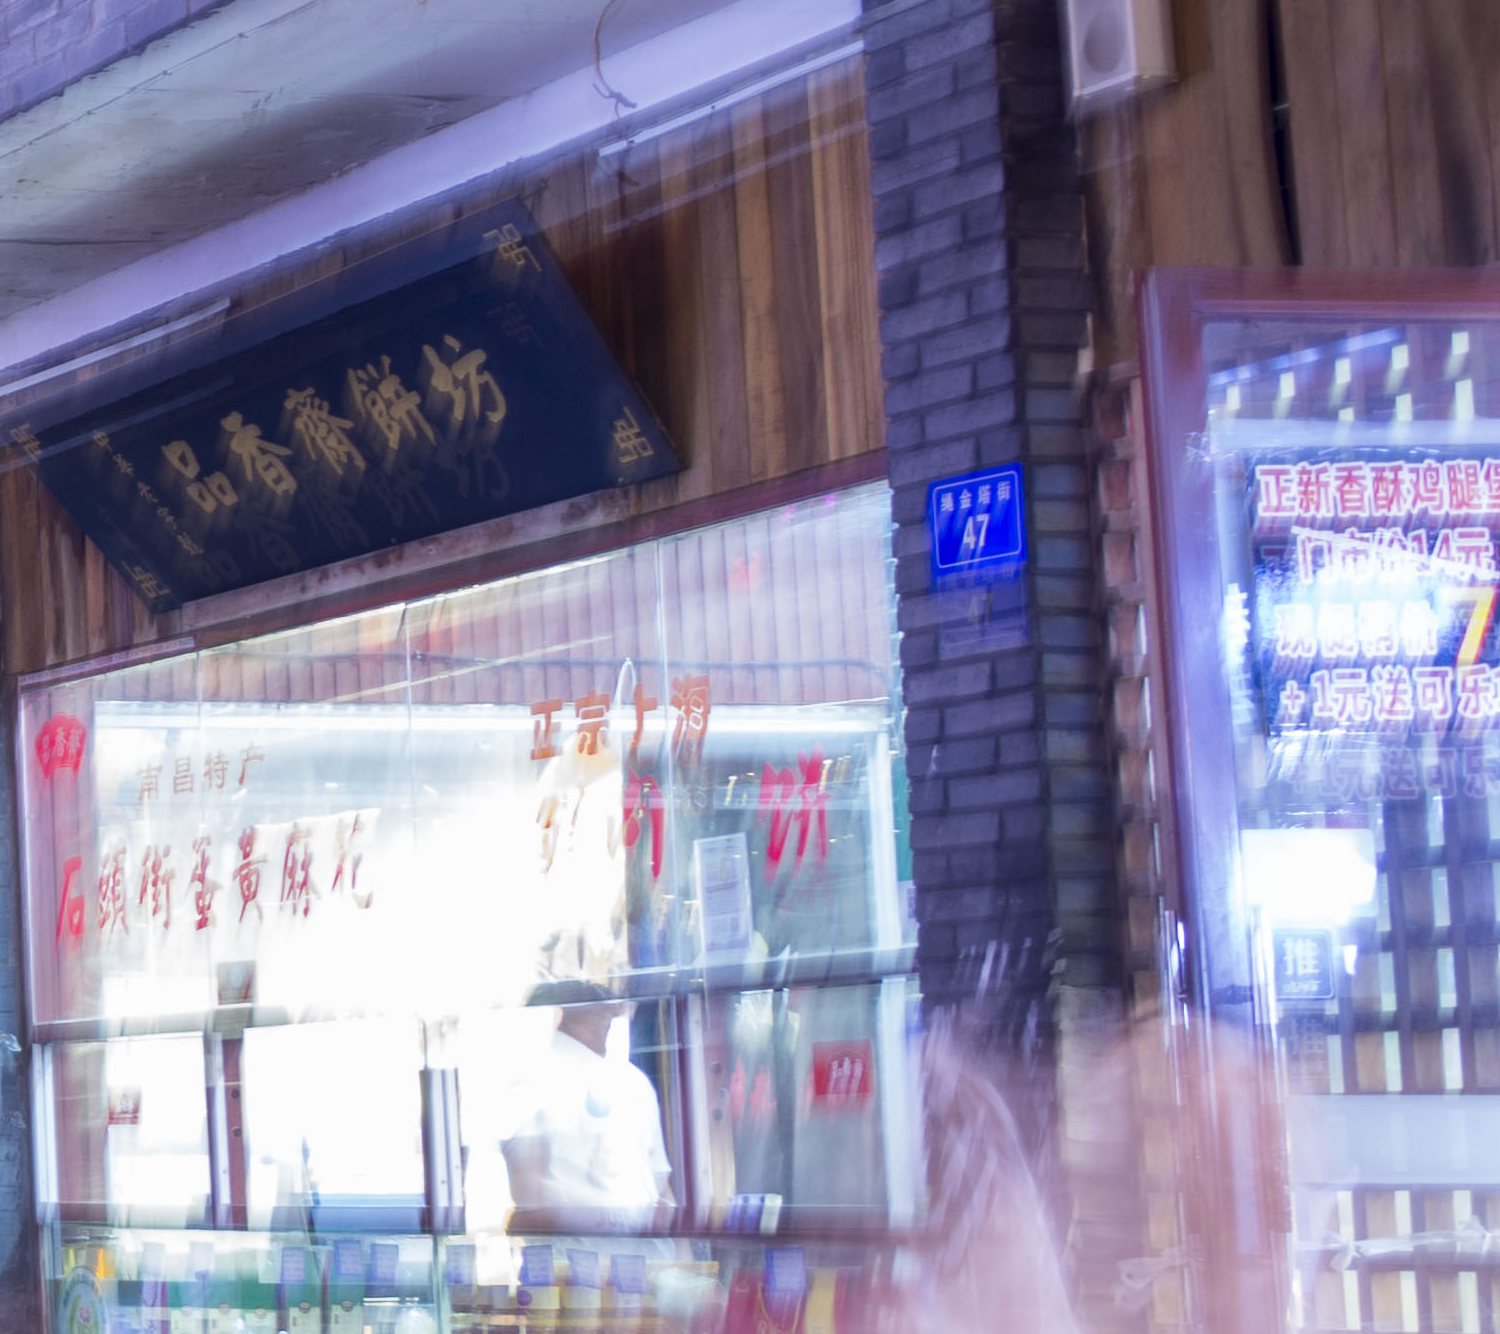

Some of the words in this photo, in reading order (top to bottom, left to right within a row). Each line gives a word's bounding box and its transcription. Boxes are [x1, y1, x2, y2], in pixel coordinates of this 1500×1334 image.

[941, 480, 1011, 513] 绳金塔街
[963, 514, 990, 550] 47
[138, 744, 266, 801] 南昌特产
